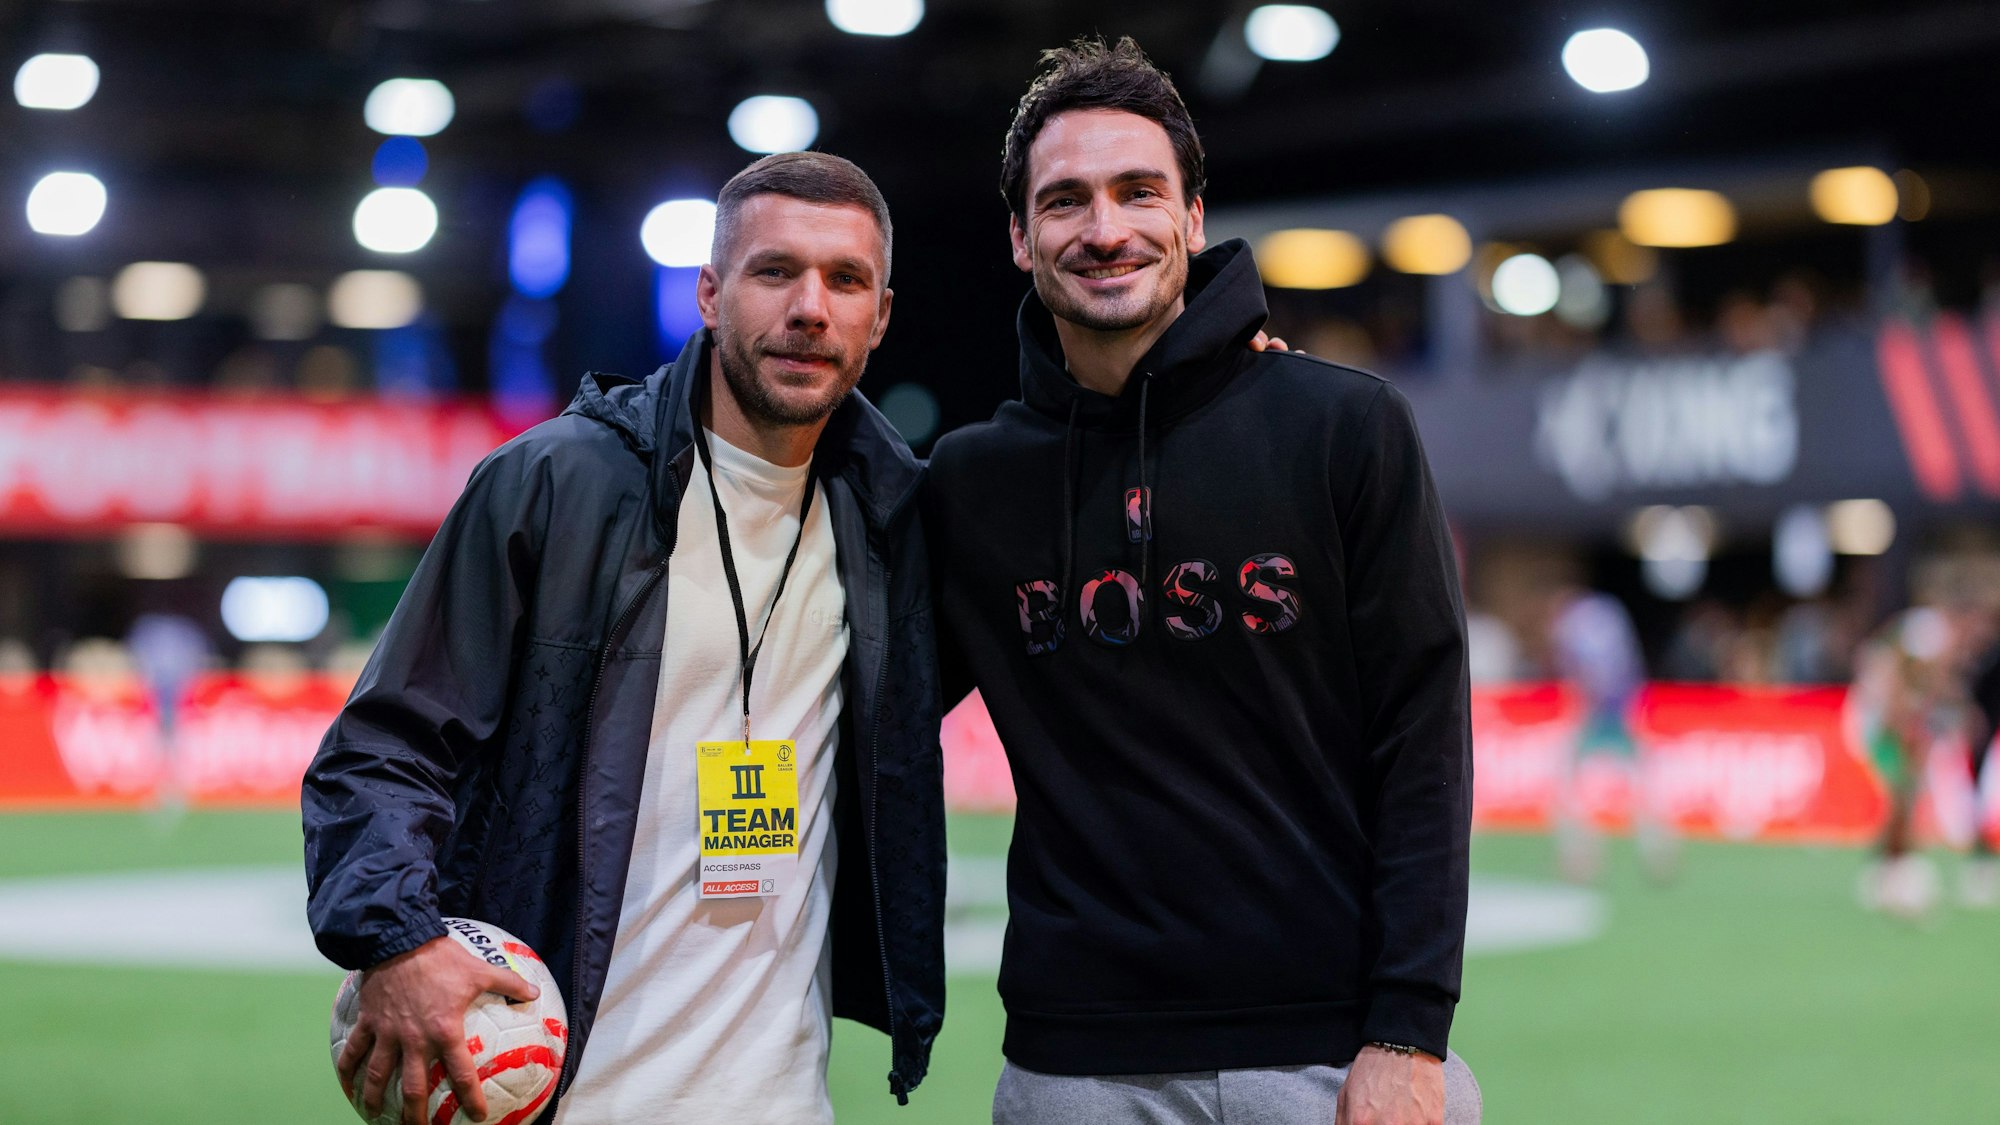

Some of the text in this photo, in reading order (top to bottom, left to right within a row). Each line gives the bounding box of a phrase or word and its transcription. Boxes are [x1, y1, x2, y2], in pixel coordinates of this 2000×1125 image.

[1015, 552, 1301, 656] BOSS
[730, 764, 766, 800] III
[703, 807, 795, 833] TEAM
[704, 833, 794, 850] MANAGER
[703, 863, 761, 872] ACCESS PASS
[704, 882, 758, 893] ALL ACCESS
[444, 919, 512, 970] BYSTAR
